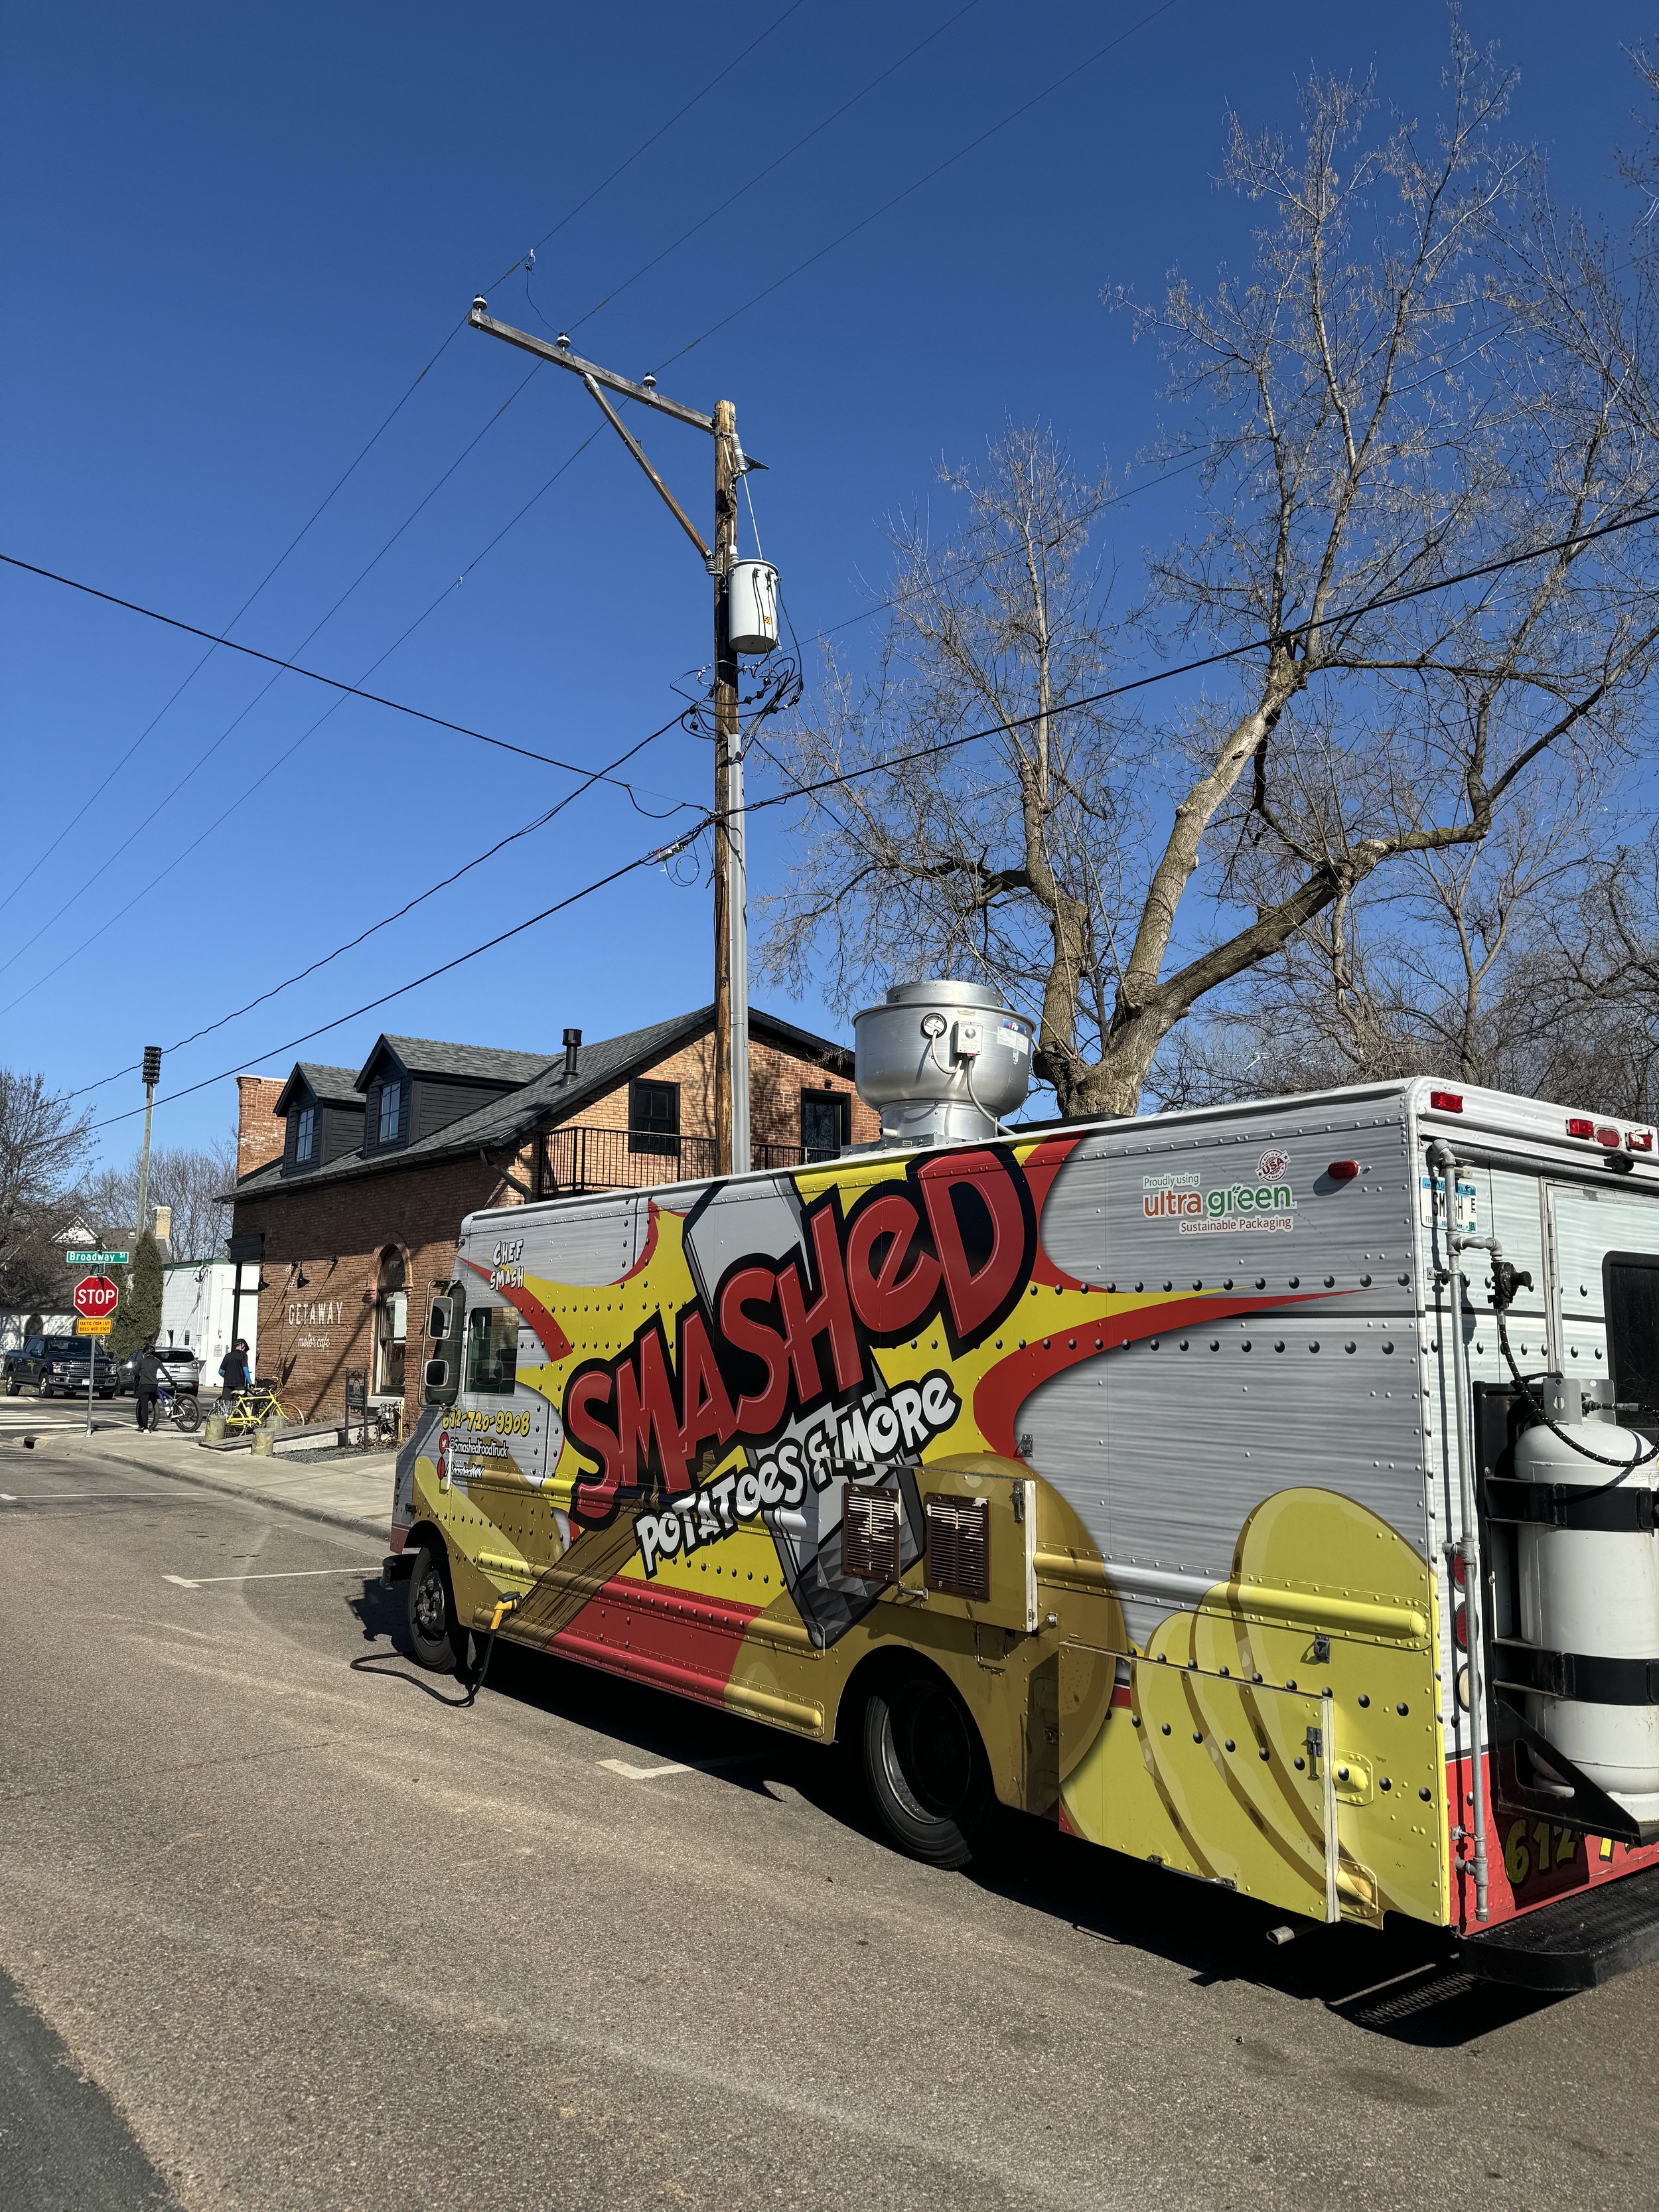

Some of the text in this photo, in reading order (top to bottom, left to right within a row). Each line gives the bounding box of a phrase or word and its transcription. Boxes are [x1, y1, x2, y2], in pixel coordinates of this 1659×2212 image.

[1262, 1157, 1284, 1175] USA
[1145, 1174, 1198, 1187] Proudly using
[1145, 1190, 1201, 1217] ultra
[1208, 1186, 1291, 1218] green
[1433, 1191, 1463, 1220] SMH
[1181, 1217, 1291, 1232] Sustainable Packaging
[70, 1252, 115, 1262] Broadway
[492, 1239, 524, 1267] CHEF
[490, 1266, 524, 1291] SMASH
[77, 1289, 115, 1305] STOP
[289, 1301, 342, 1325] GETAWAY
[297, 1333, 316, 1347] motor
[442, 1409, 530, 1436] 612-720-9908
[449, 1438, 508, 1457] @SmashedFoodTruck
